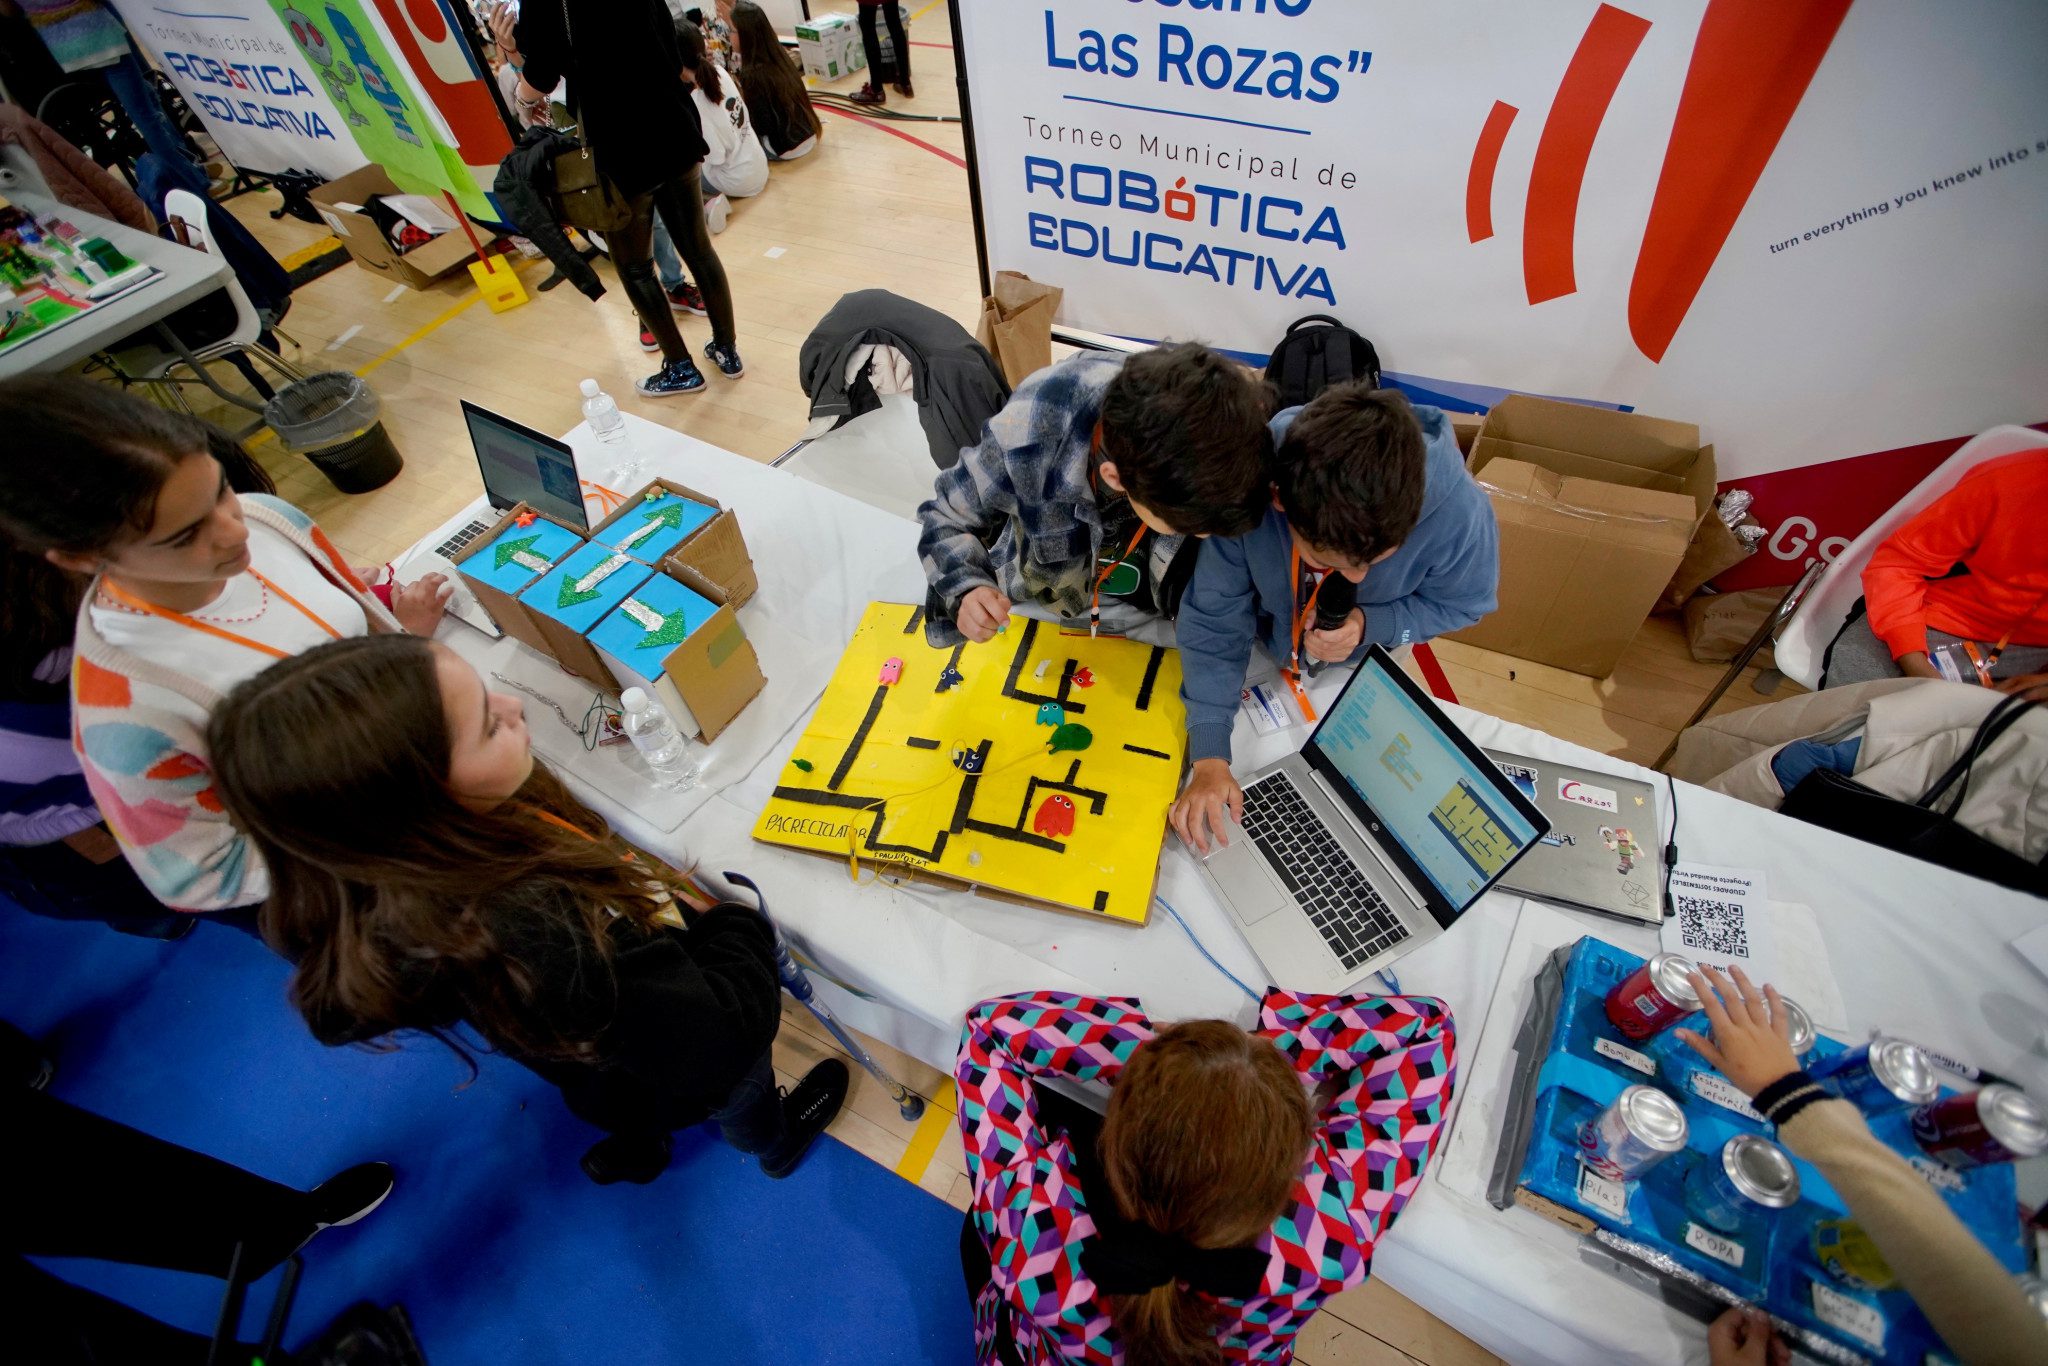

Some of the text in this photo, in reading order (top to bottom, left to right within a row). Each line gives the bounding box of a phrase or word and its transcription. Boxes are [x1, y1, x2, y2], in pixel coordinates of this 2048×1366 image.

[146, 23, 287, 55] Torneo Municipal de
[1045, 10, 1139, 78] Las
[192, 92, 336, 140] EDUCATIVA
[1023, 116, 1357, 189] Torneo Municipal de
[1769, 236, 1799, 254] turn
[1803, 201, 1890, 242] everything
[1894, 187, 1928, 208] you
[1932, 165, 1983, 192] knew
[1989, 148, 2029, 171] into
[1028, 211, 1336, 306] EDUCATIVA
[1672, 879, 1746, 896] CIUDADES SOSTENIBLES
[1690, 872, 1718, 882] Realidad
[1584, 1178, 1619, 1207] Pilas
[1693, 1228, 1736, 1262] ROPA
